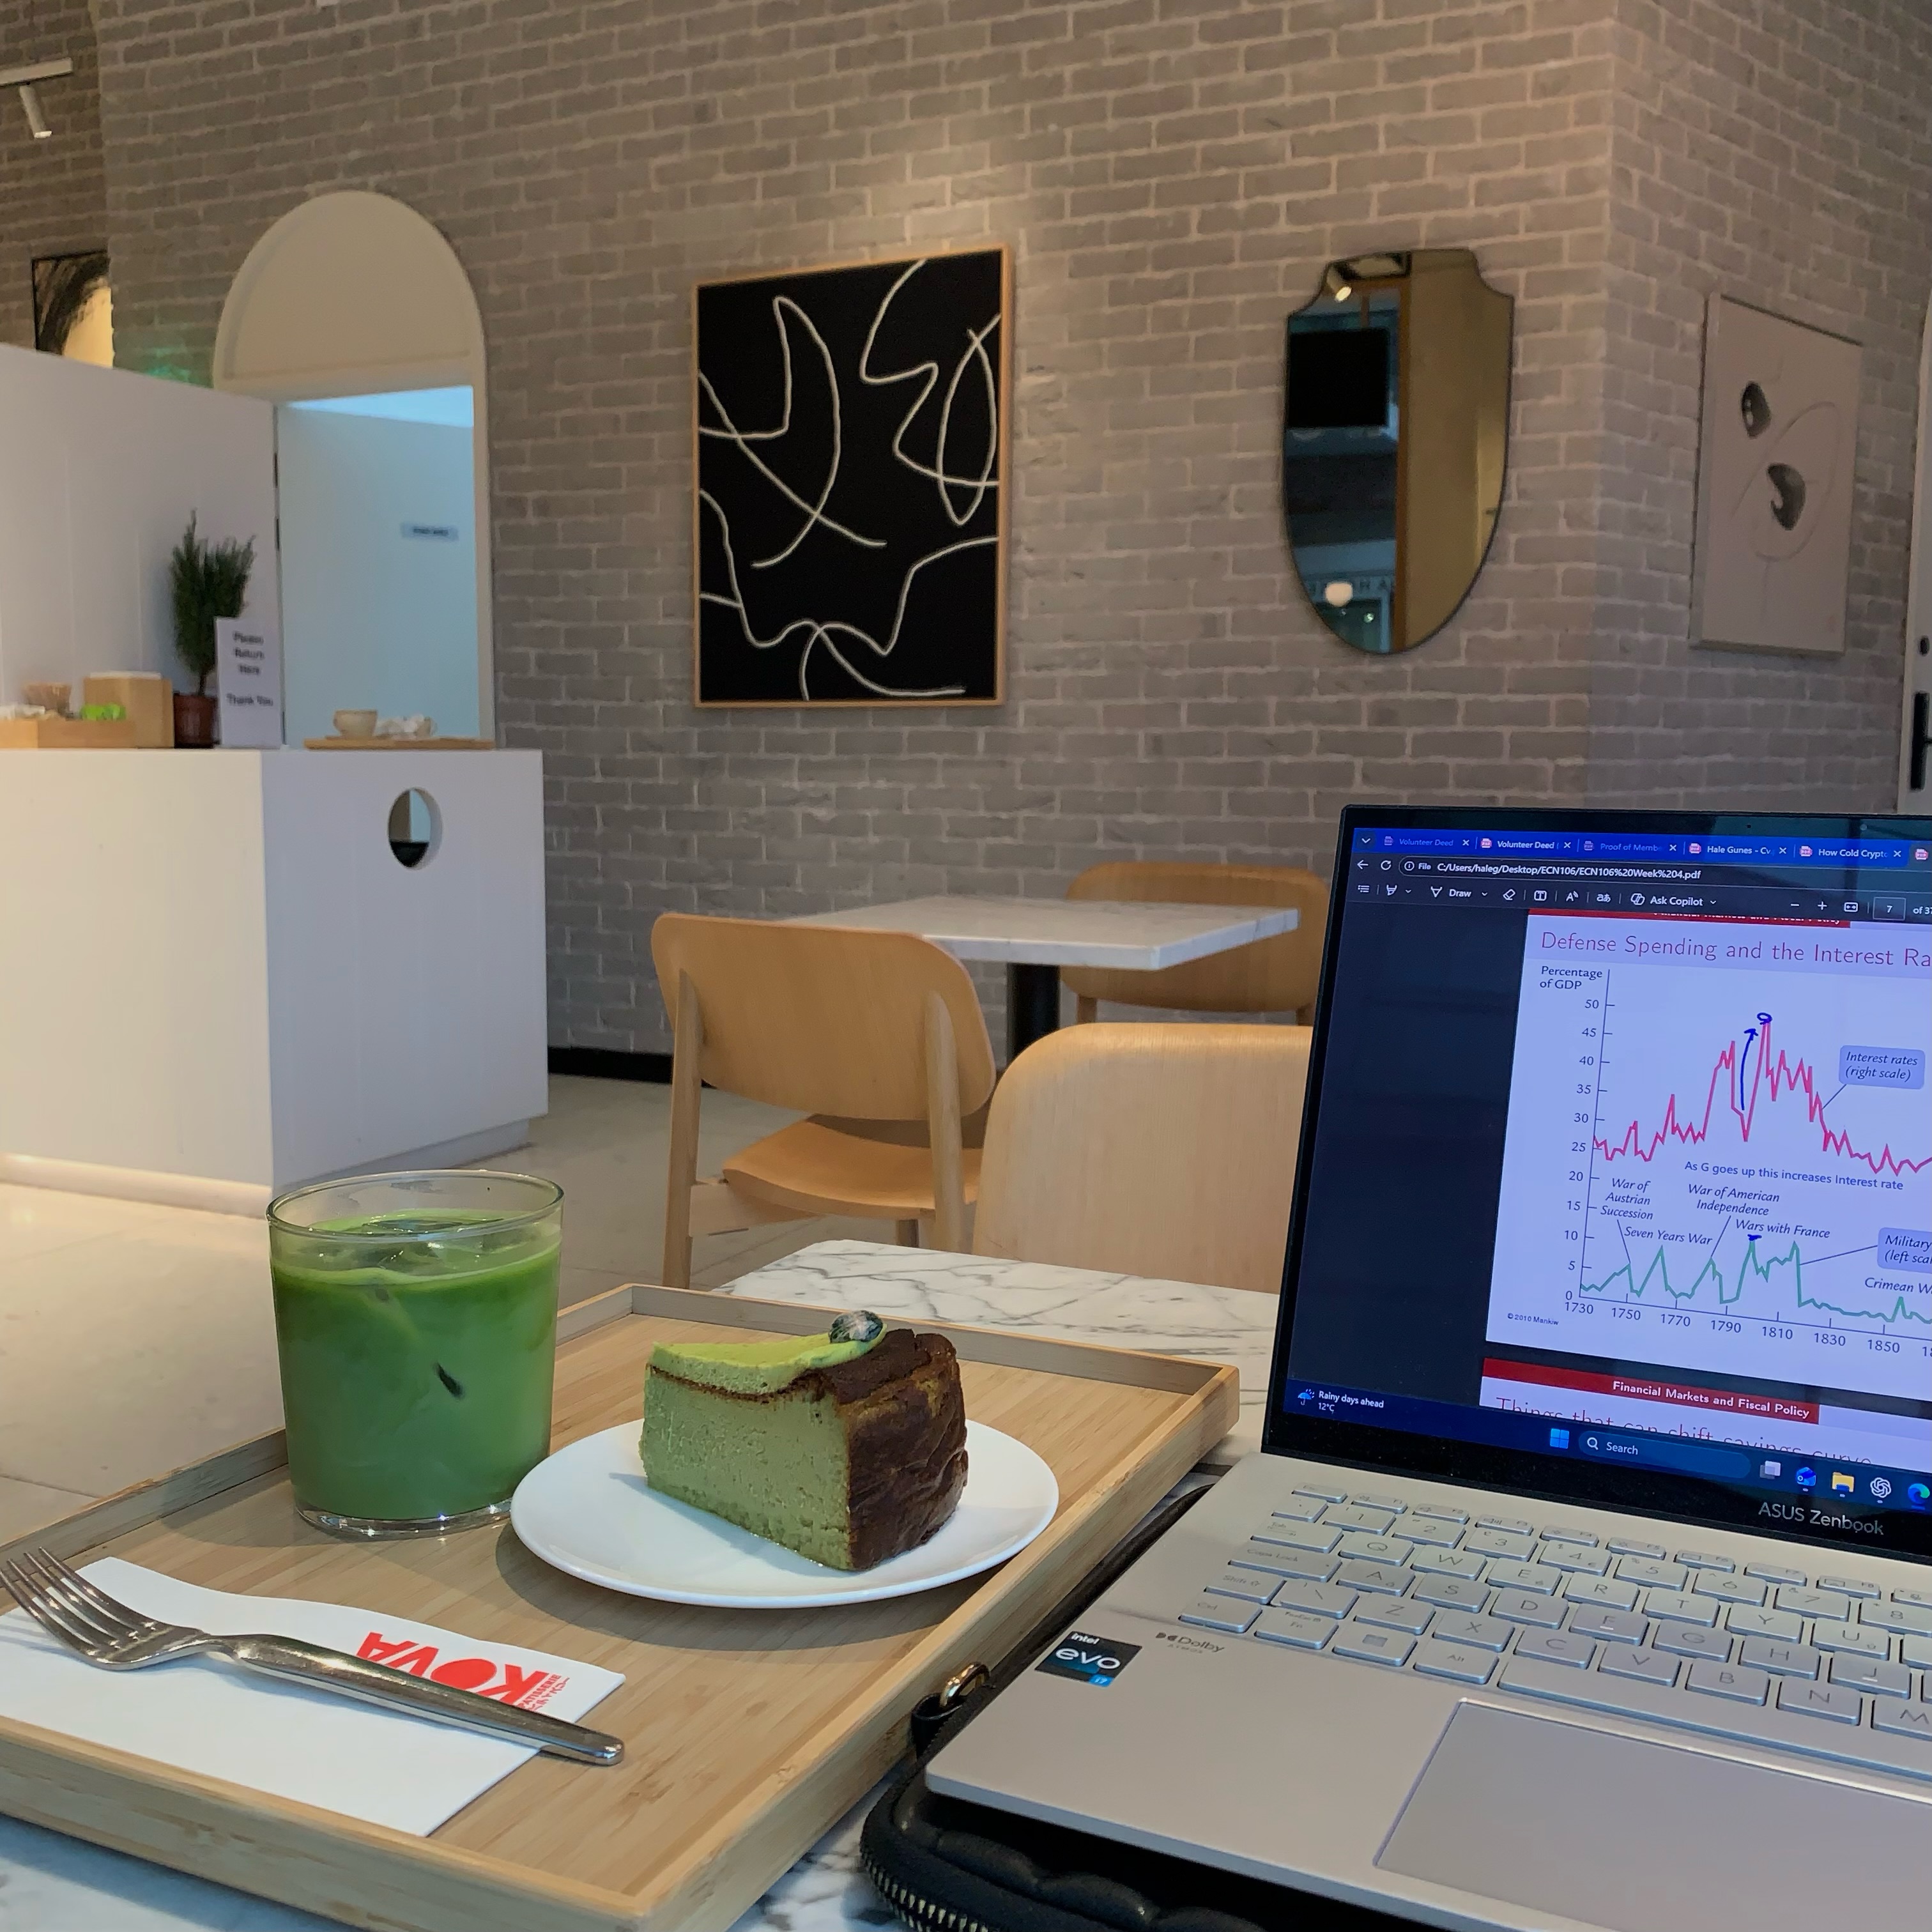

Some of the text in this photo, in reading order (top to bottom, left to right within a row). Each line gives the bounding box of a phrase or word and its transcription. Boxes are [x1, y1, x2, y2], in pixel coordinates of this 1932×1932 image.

[1399, 838, 1432, 846] Volunteer
[1497, 841, 1554, 850] Volunteer Deed
[1727, 847, 1752, 855] Gunes
[1818, 848, 1837, 857] How
[1839, 849, 1859, 857] Cold
[1437, 864, 1701, 881] C:/Users/haleg/Desktop/ECN106/ECN106%20Week%204.pdf
[1448, 889, 1472, 898] Draw
[1650, 896, 1704, 907] Ask Copilot
[1886, 905, 1893, 914] 7
[1912, 906, 1923, 914] of
[1541, 931, 1617, 952] Defense
[1624, 935, 1718, 962] Spending
[1726, 940, 1762, 960] and
[1772, 942, 1805, 962] the
[1814, 944, 1894, 966] Interest
[1541, 965, 1603, 981] Percentage
[1539, 979, 1582, 990] of GDP
[1584, 999, 1600, 1009] 50
[1581, 1027, 1597, 1038] 45
[1579, 1055, 1595, 1066] 40
[1846, 1051, 1918, 1067] Interest rates
[1845, 1065, 1912, 1083] (right scale)
[1576, 1084, 1592, 1095] 35
[1574, 1112, 1590, 1123] 30
[1571, 1142, 1586, 1152] 25
[1568, 1170, 1584, 1182] 20
[1684, 1160, 1904, 1191] As G goes up this increases Interest rate
[1612, 1177, 1652, 1193] War of
[1688, 1183, 1781, 1202] War of American
[1605, 1192, 1652, 1206] Austrian
[1567, 1200, 1581, 1211] 15
[1696, 1199, 1770, 1216] Independence
[1600, 1205, 1654, 1221] Succession
[1735, 1218, 1831, 1239] Wars with France
[1564, 1230, 1579, 1241] 10
[1623, 1226, 1713, 1246] Seven Years War
[1884, 1234, 1932, 1252] Military
[1884, 1249, 1910, 1264] (left
[1567, 1261, 1576, 1271] 5
[1864, 1276, 1932, 1294] Crimean W
[1565, 1290, 1573, 1301] 0
[1564, 1301, 1594, 1315] 1730
[1611, 1307, 1641, 1321] 1750
[1660, 1313, 1691, 1327] 1770
[1710, 1319, 1742, 1333] 1790
[1761, 1326, 1793, 1340] 1810
[1813, 1332, 1846, 1347] 1830
[1867, 1338, 1901, 1354] 1850
[1318, 1390, 1384, 1409] Rainy days ahead
[1612, 1380, 1810, 1420] Financial Markets and Fiscal Policy
[1318, 1402, 1335, 1414] 12°C
[1606, 1441, 1639, 1456] Search
[1758, 1501, 1885, 1535] ASUS Zenbook
[1423, 1525, 1437, 1533] 2
[1367, 1542, 1388, 1552] Q
[1495, 1538, 1508, 1547] 3
[1438, 1554, 1464, 1566] W
[1568, 1552, 1583, 1560] 4
[1365, 1571, 1383, 1581] A
[1517, 1568, 1533, 1579] E
[1645, 1566, 1660, 1575] 5
[1444, 1584, 1460, 1595] S
[1594, 1583, 1609, 1595] R
[1519, 1599, 1539, 1611] D
[1676, 1598, 1690, 1609] T
[1384, 1604, 1406, 1616] Z
[1890, 1610, 1904, 1620] 8
[1602, 1615, 1616, 1625] F
[1758, 1614, 1775, 1625] Y
[1465, 1621, 1483, 1634] X
[1681, 1632, 1706, 1644] G
[1842, 1629, 1860, 1641] U
[1178, 1636, 1225, 1653] Dolby
[1545, 1638, 1567, 1650] C
[1055, 1647, 1121, 1670] evo
[1631, 1653, 1652, 1666] V
[1769, 1648, 1790, 1661] H
[356, 1631, 550, 1706] KOVA
[1719, 1671, 1735, 1685] B
[516, 1674, 562, 1710] PATISSERIE
[1808, 1689, 1832, 1704] N
[1899, 1708, 1930, 1726] M
